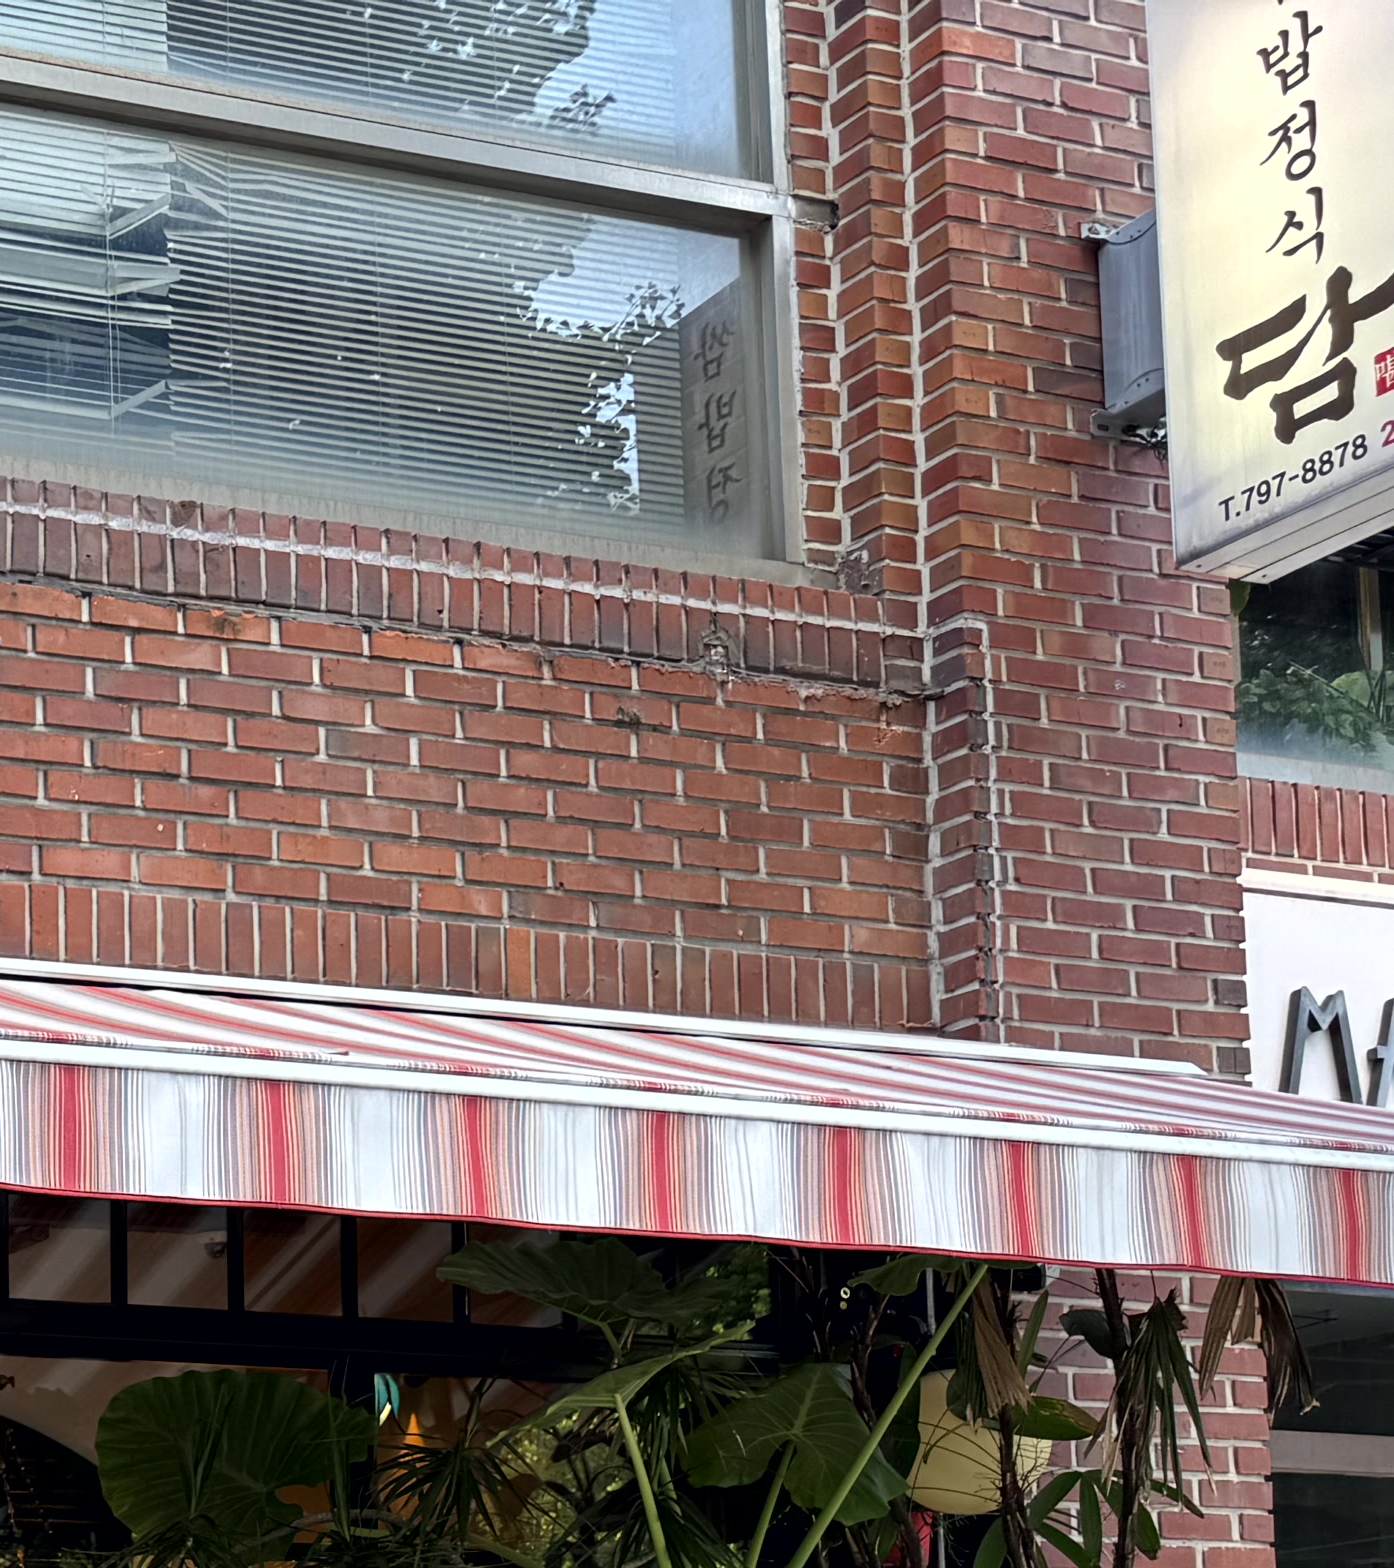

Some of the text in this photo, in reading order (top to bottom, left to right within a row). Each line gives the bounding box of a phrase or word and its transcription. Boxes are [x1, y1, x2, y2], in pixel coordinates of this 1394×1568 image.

[1256, 0, 1323, 264] 밥정식
[1216, 266, 1394, 445] 담
[1219, 432, 1369, 523] T.797-8878
